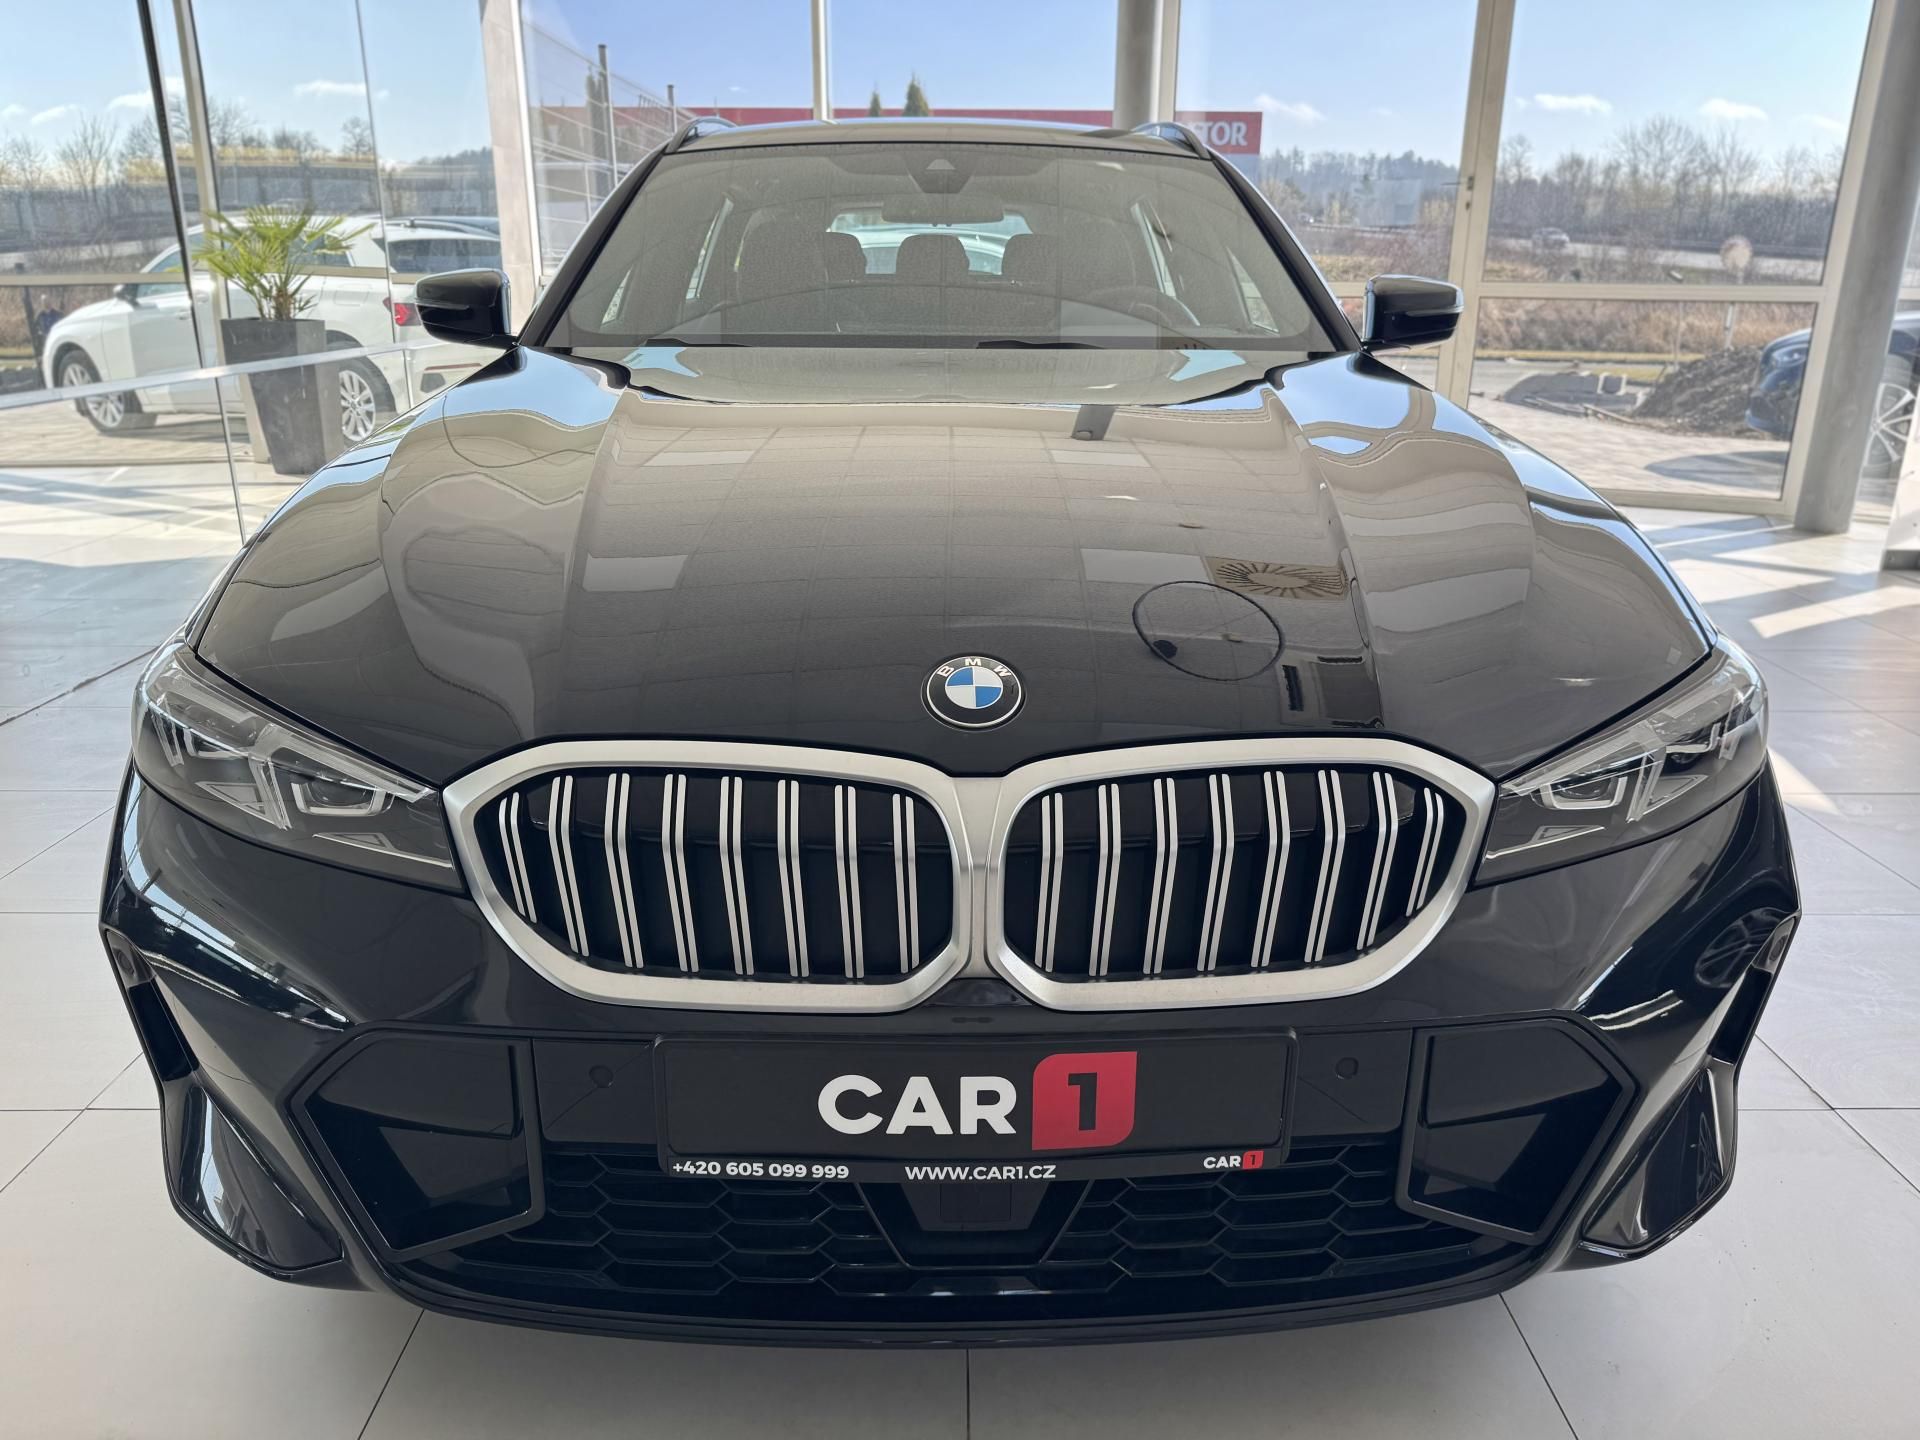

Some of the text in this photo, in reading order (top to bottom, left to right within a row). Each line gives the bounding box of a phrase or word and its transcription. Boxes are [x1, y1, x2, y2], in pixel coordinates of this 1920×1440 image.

[1192, 121, 1248, 146] TOR
[936, 658, 1012, 678] BMW
[672, 1160, 850, 1179] +420 605 099 999
[904, 1164, 1057, 1180] WWW.CAR1.CZ
